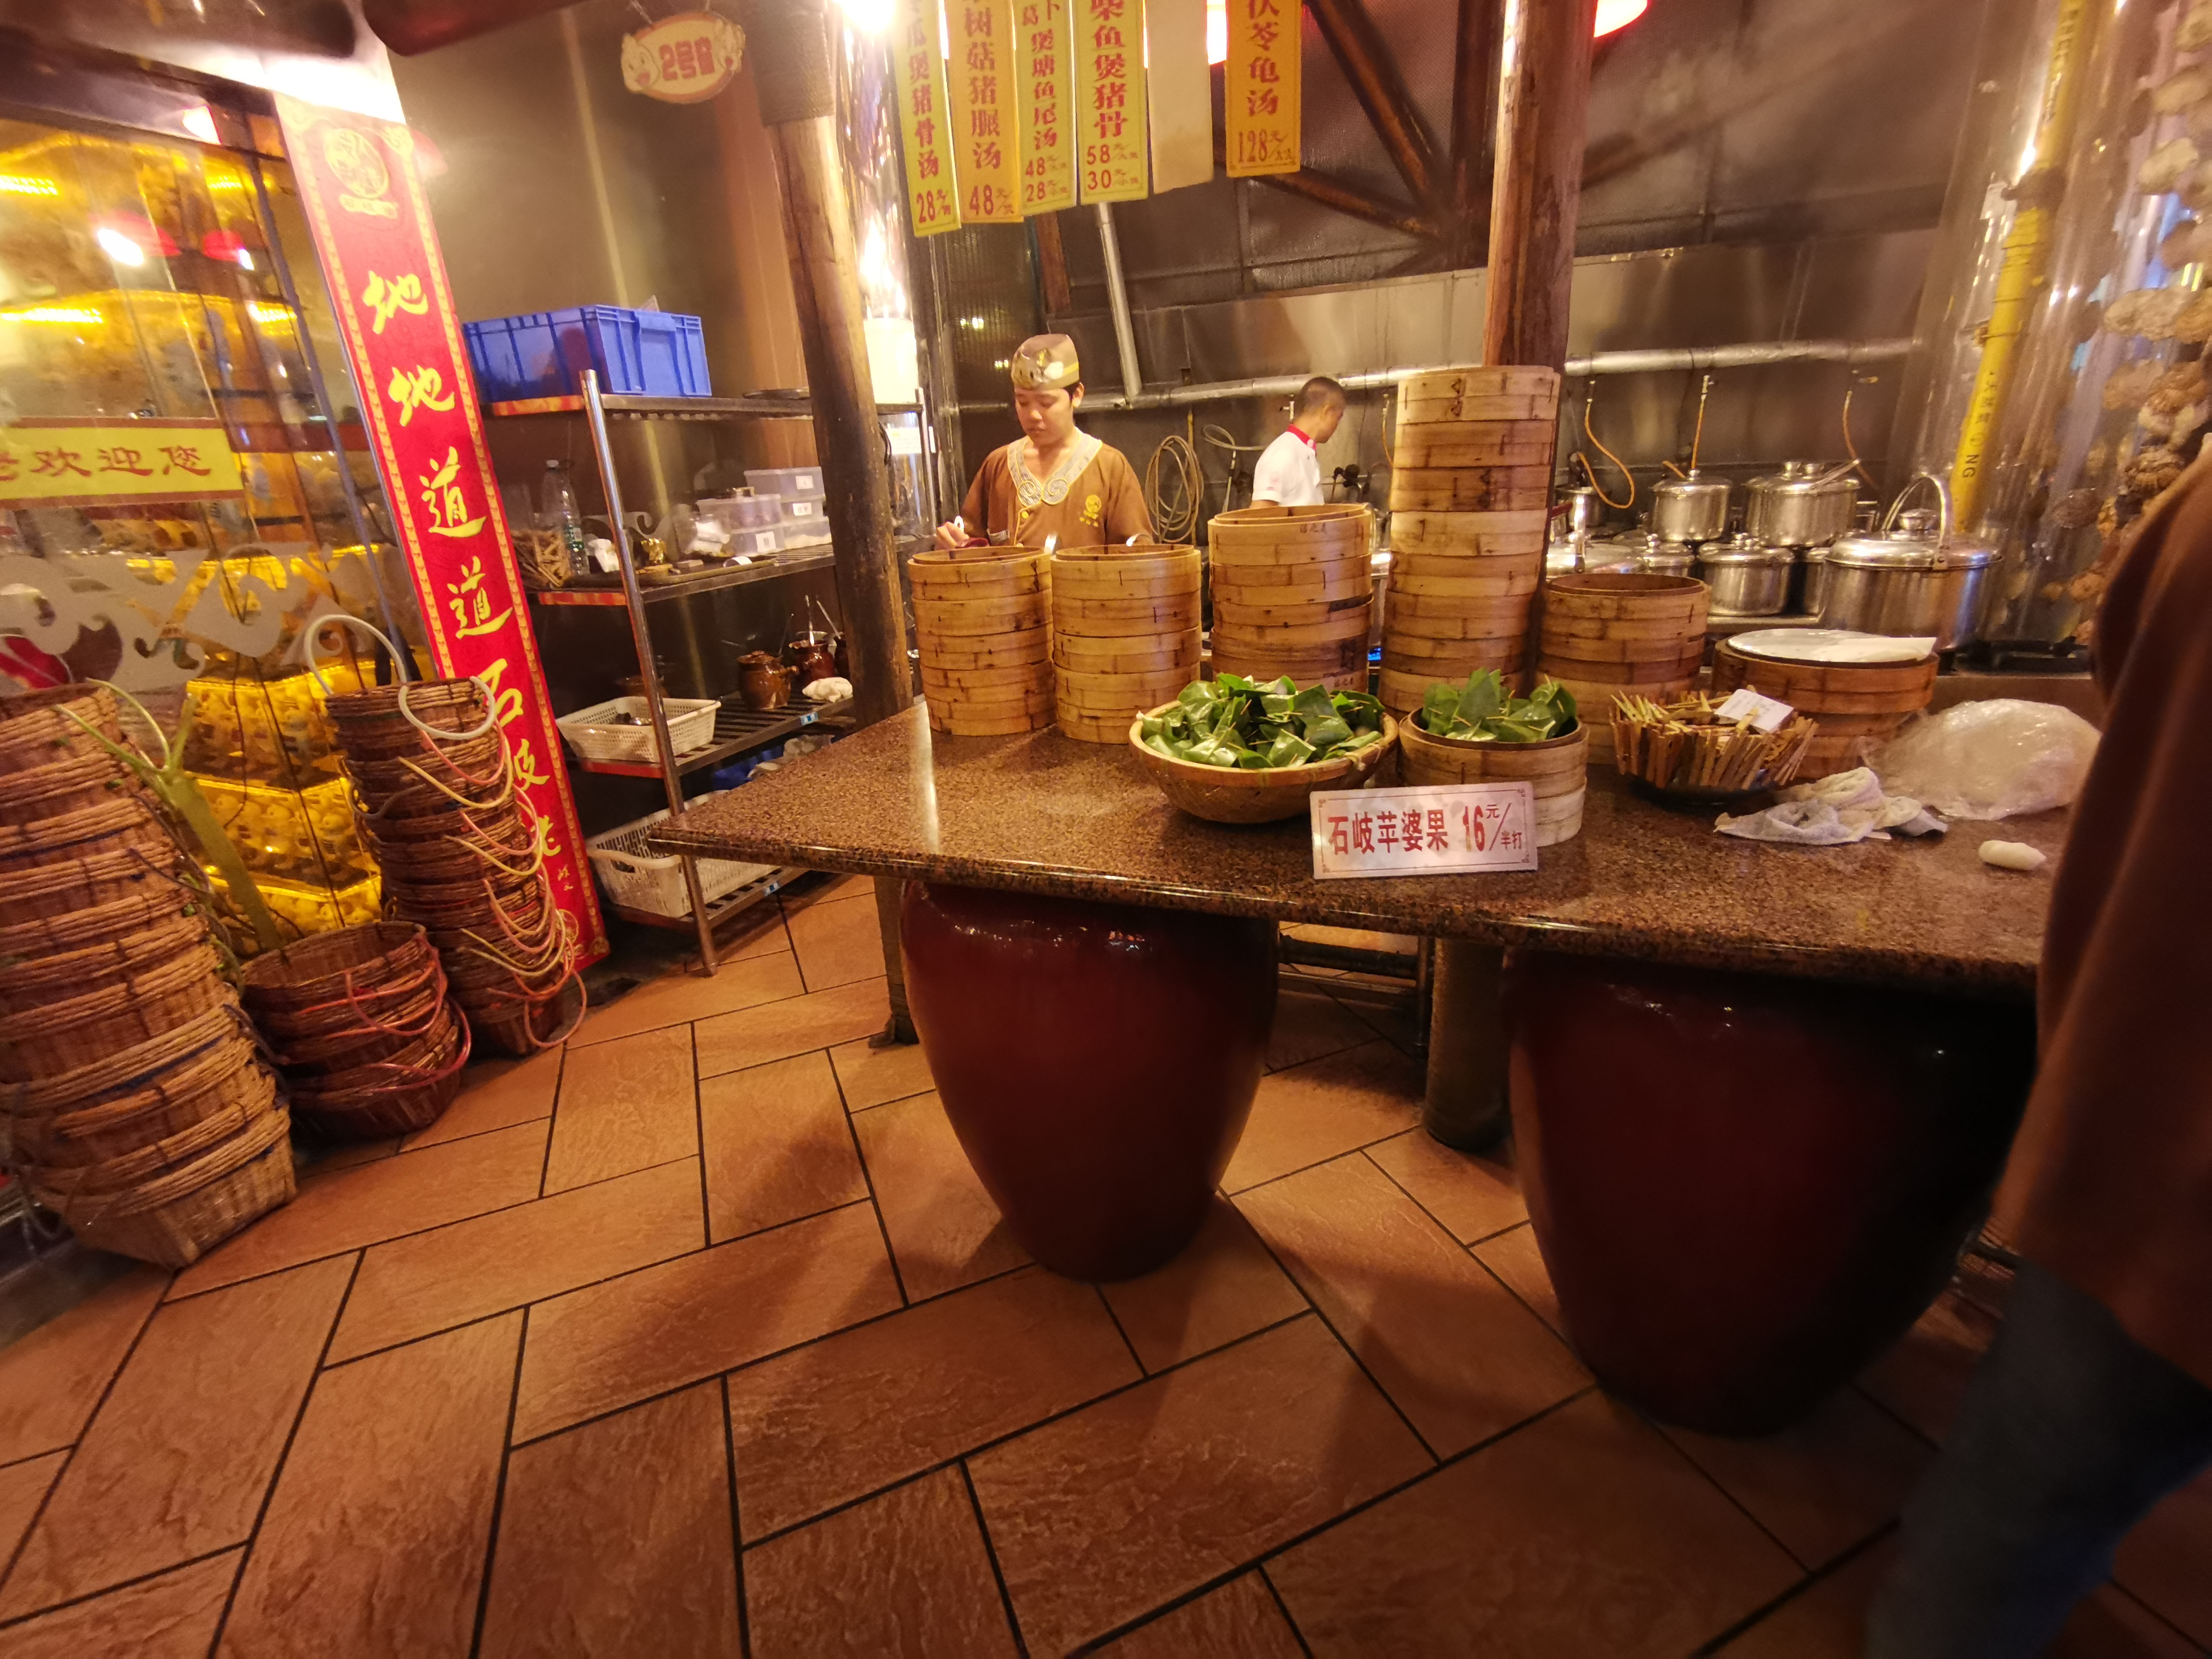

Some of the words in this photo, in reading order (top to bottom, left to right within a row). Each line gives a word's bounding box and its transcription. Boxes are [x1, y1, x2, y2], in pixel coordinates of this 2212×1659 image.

[907, 0, 939, 179] 瓜煲猪骨汤
[1962, 454, 1980, 478] NG
[1327, 808, 1449, 855] 石岐苹婆果
